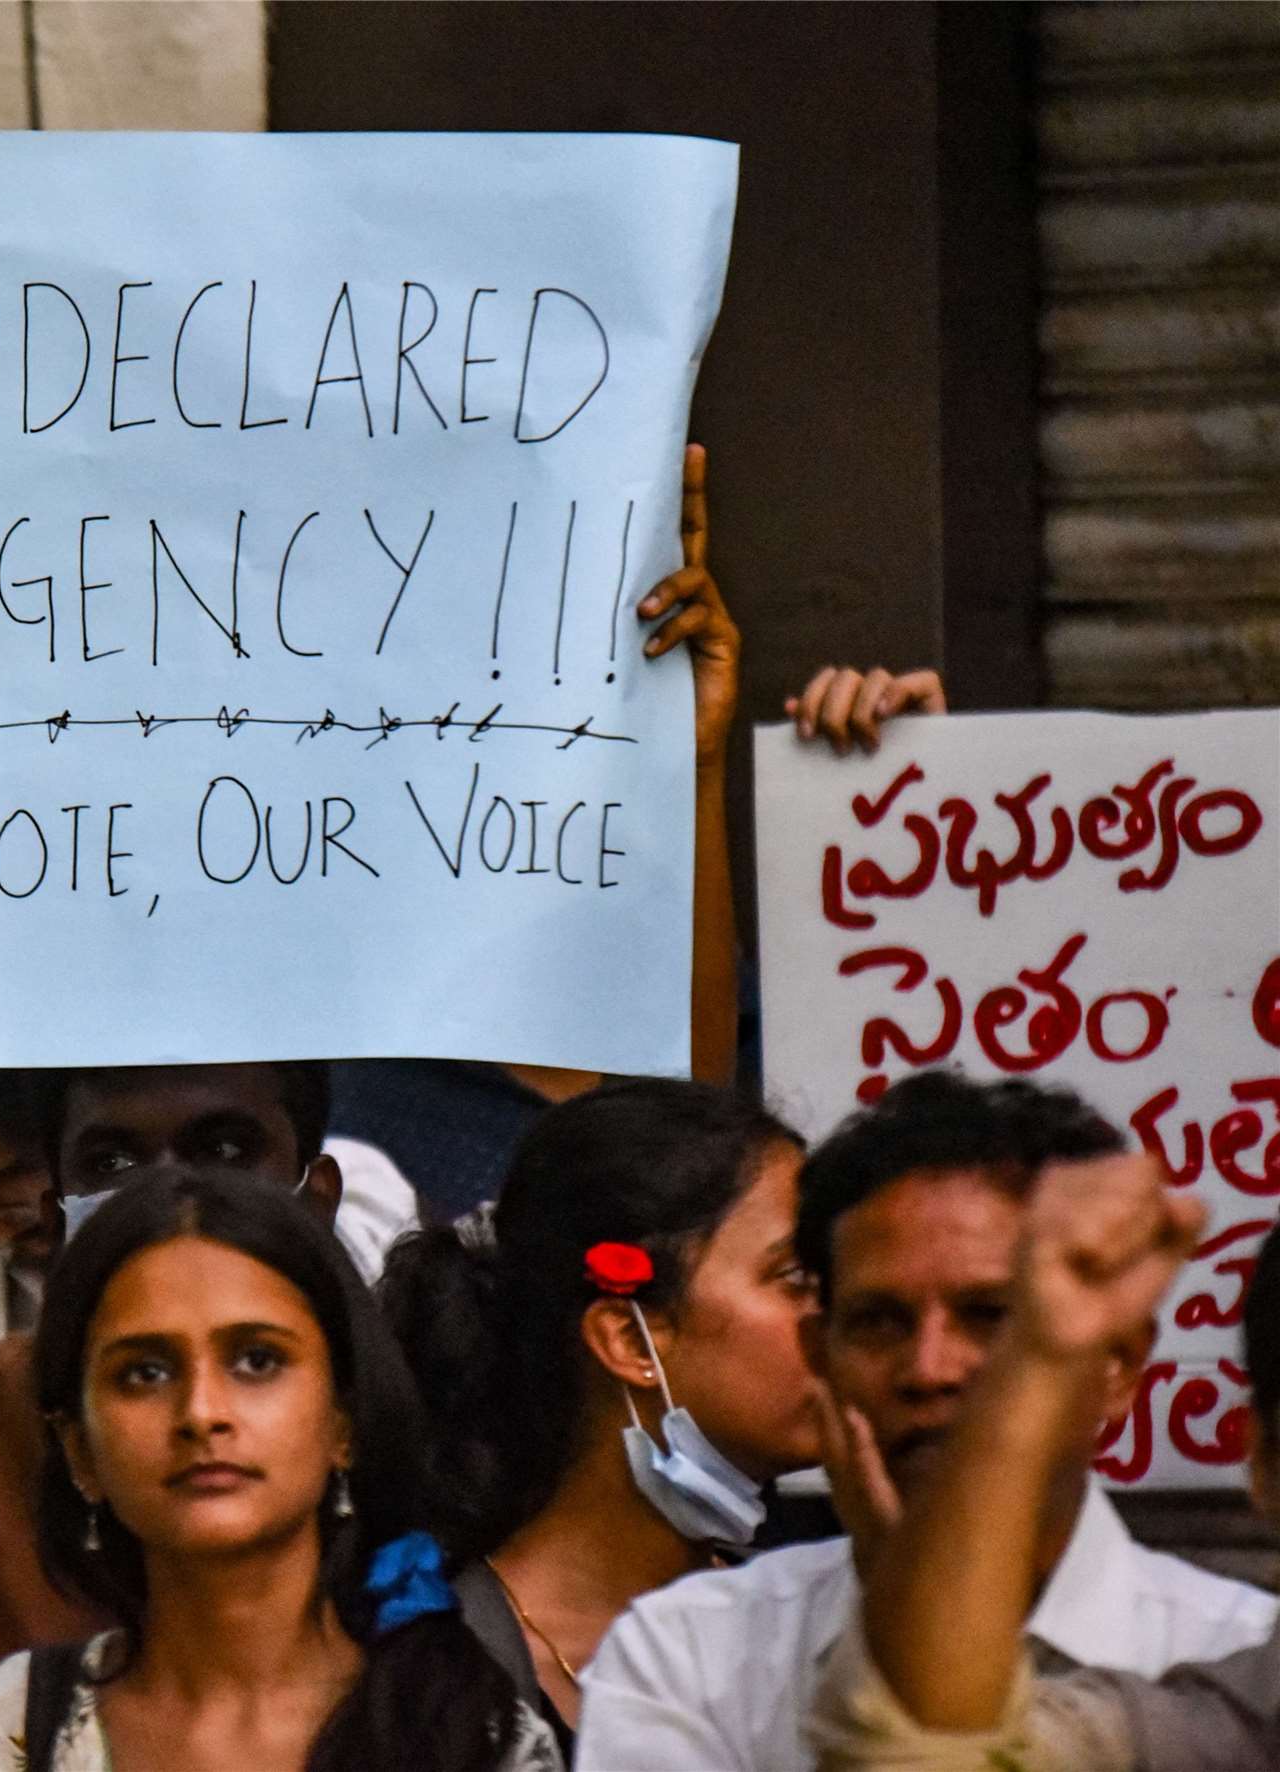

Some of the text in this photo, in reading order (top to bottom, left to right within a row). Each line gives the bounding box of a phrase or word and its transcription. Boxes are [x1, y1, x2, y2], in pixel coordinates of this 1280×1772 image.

[197, 776, 380, 886] OUR
[406, 763, 626, 888] VOICE
[822, 757, 1264, 930] ప్రభుత్వం
